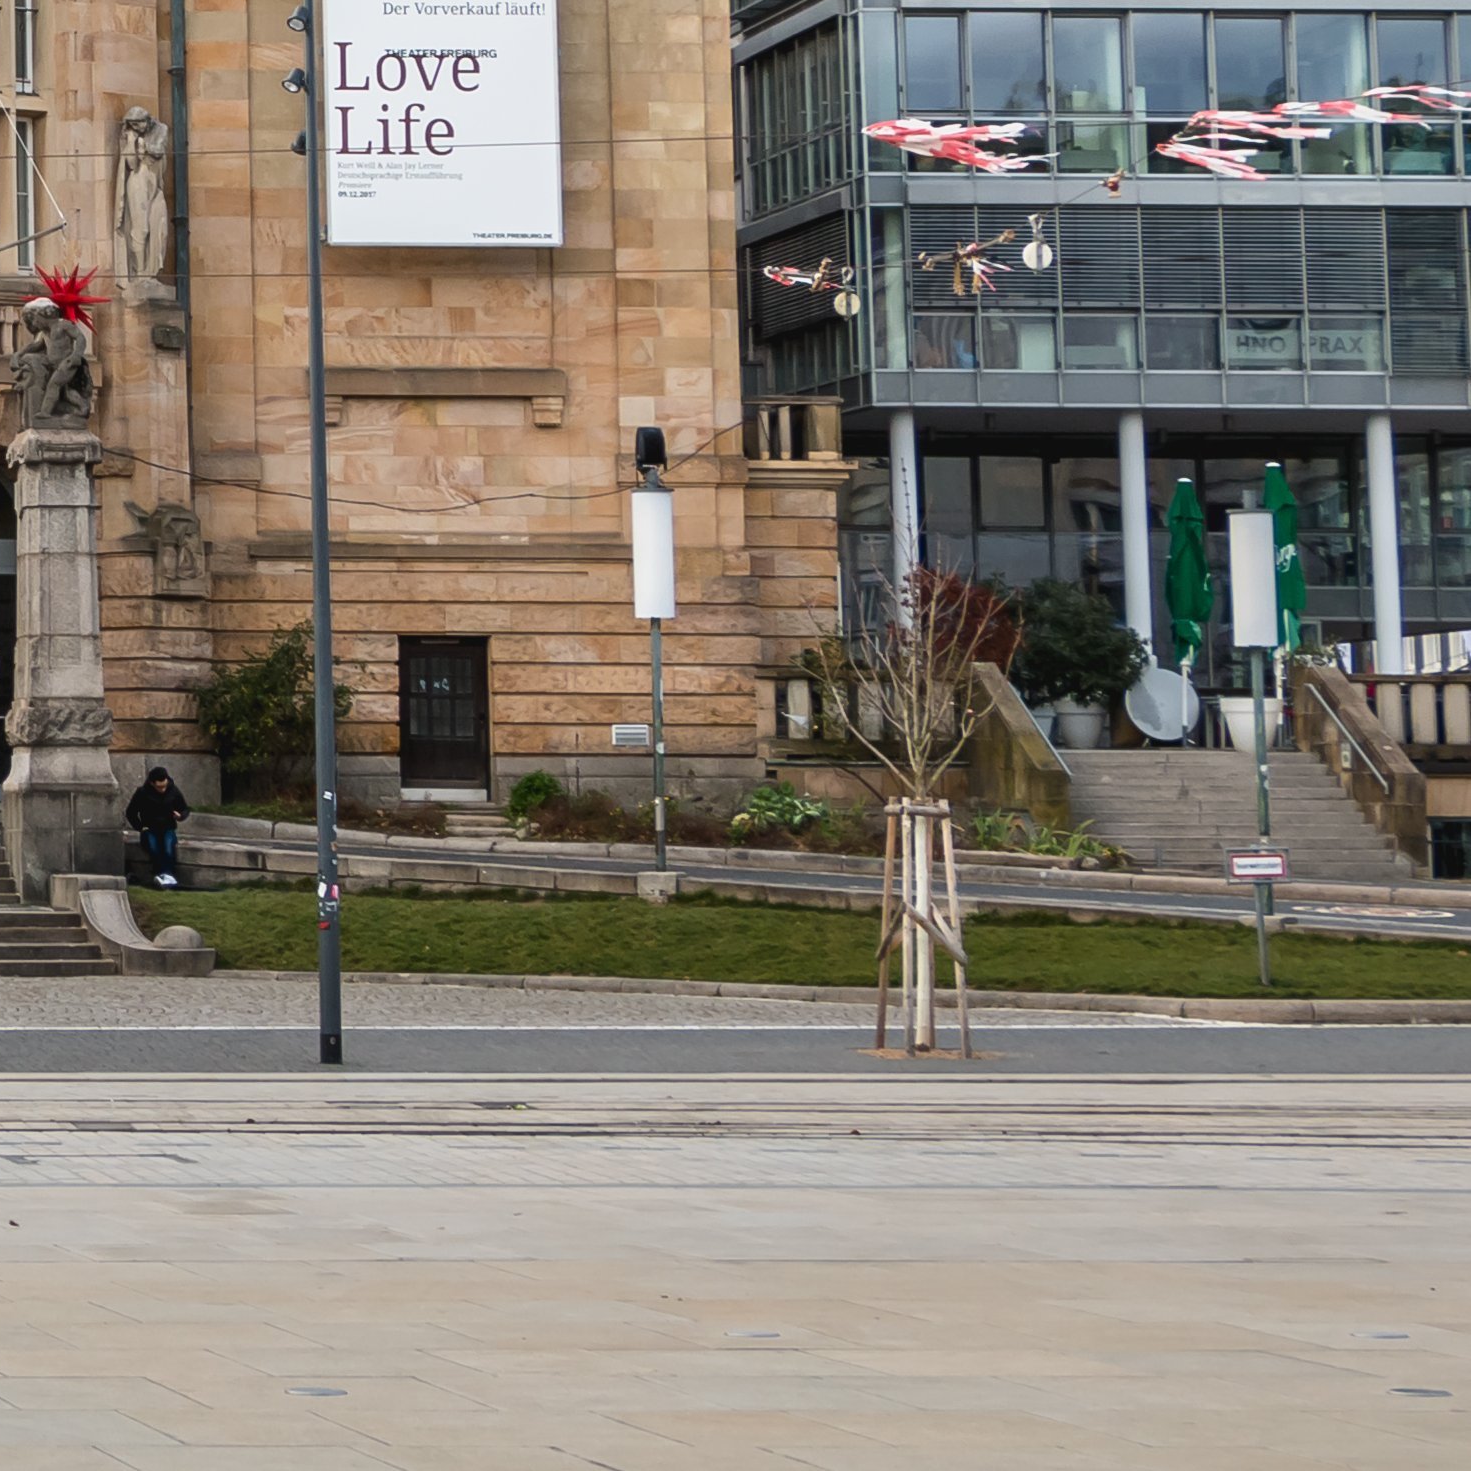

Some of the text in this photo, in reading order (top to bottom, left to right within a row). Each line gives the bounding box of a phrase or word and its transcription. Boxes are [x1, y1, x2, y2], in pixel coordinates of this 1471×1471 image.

[383, 1, 546, 16] Der Vorverkauf läuft!
[385, 48, 498, 59] THEATER FREIBURG
[333, 41, 480, 92] Love
[334, 102, 455, 156] Life
[1236, 335, 1286, 353] HNO
